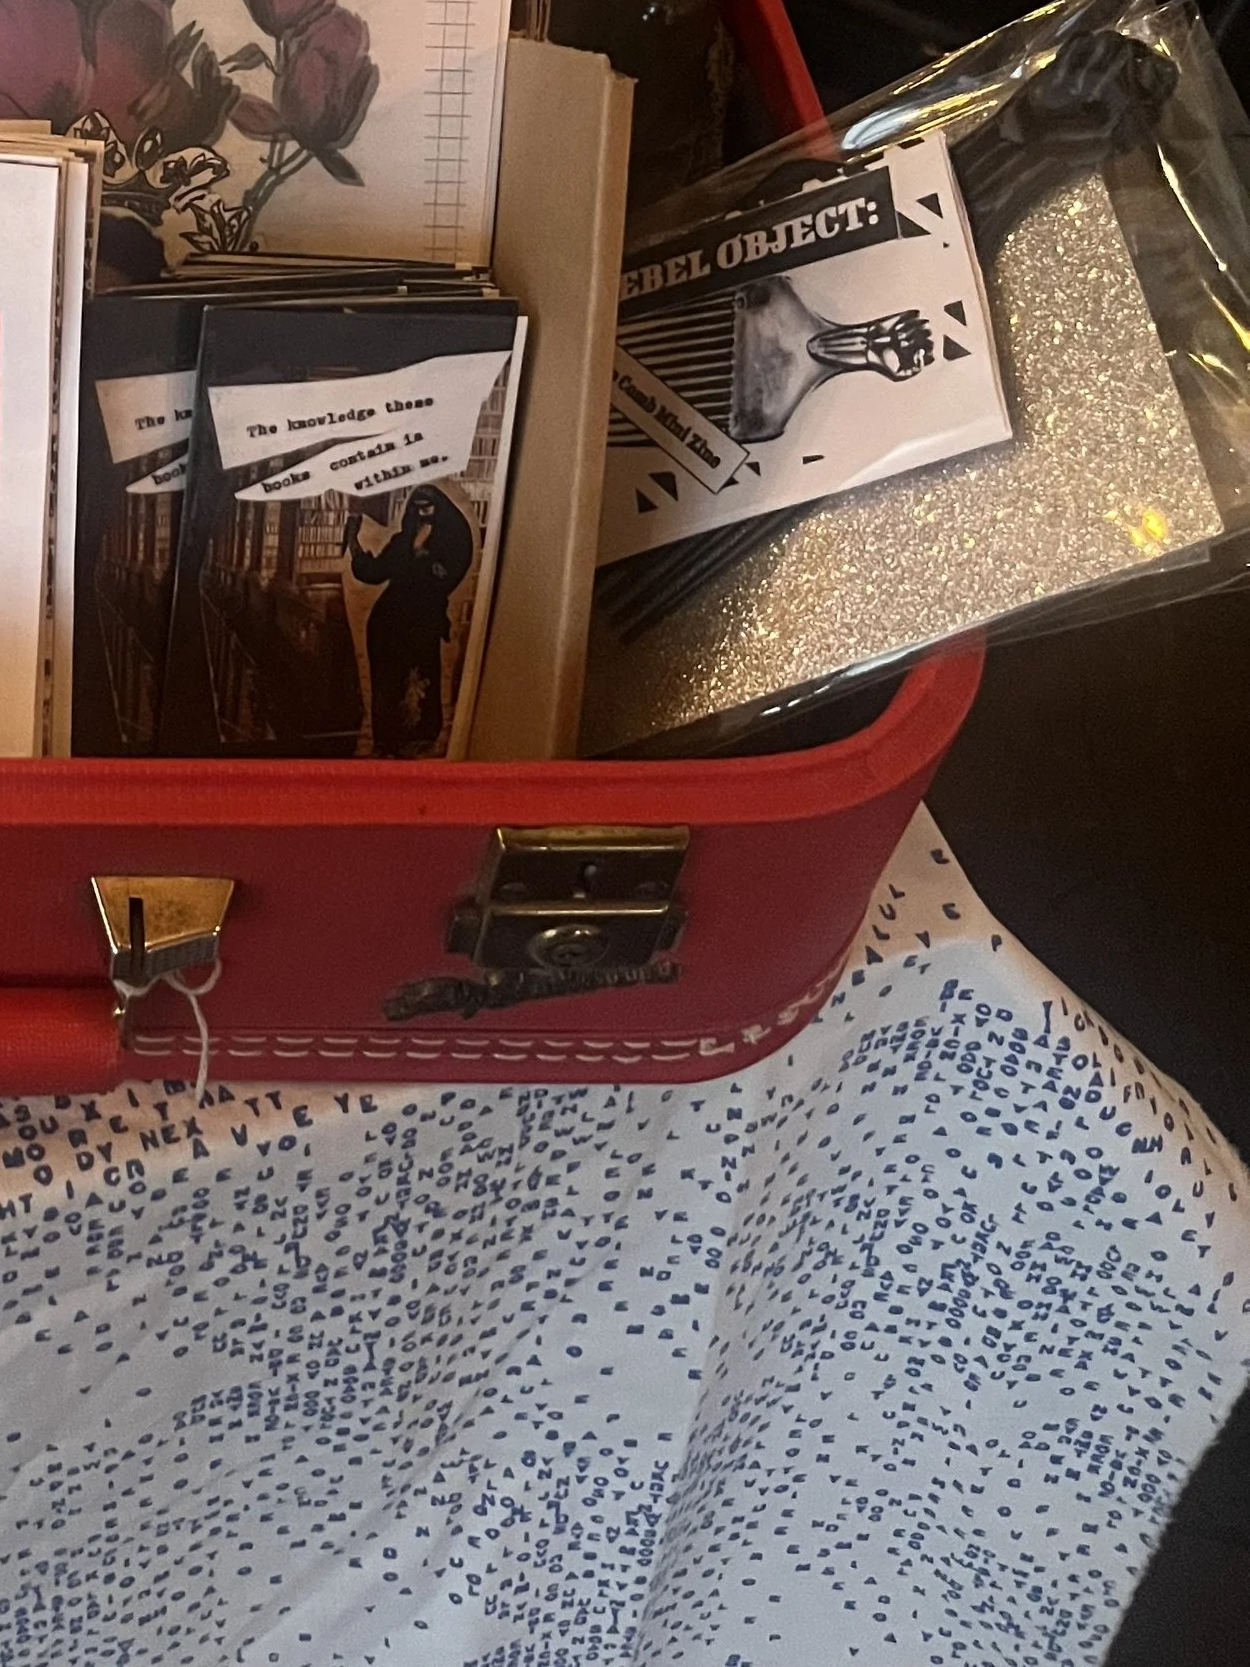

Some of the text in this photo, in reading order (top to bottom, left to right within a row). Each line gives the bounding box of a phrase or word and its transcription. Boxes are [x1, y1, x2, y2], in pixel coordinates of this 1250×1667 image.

[134, 415, 165, 430] The
[246, 424, 277, 438] The
[287, 407, 376, 431] knowledge
[261, 469, 311, 494] books
[329, 440, 396, 471] contain
[354, 464, 413, 491] within
